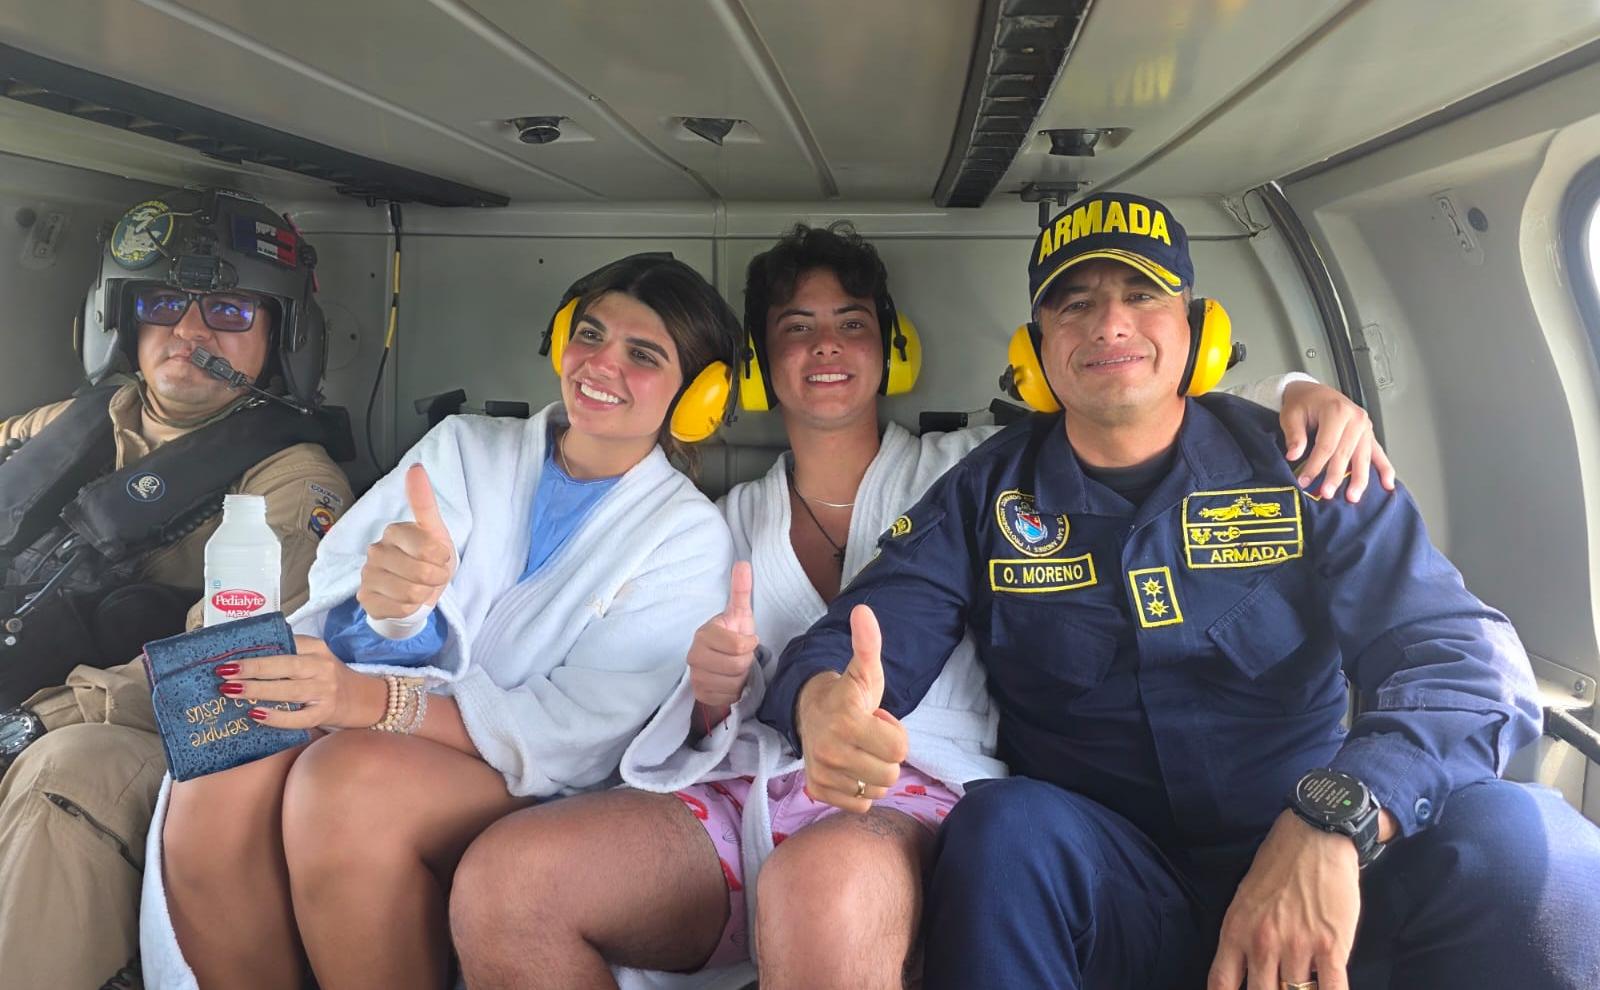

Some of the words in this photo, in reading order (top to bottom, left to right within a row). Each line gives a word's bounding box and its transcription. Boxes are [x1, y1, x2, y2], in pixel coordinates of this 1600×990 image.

[1038, 200, 1171, 265] ARMADA
[1210, 546, 1288, 563] ARMADA
[1003, 567, 1018, 584] O.
[1022, 564, 1083, 584] MORENO
[215, 594, 264, 609] Pedialyte
